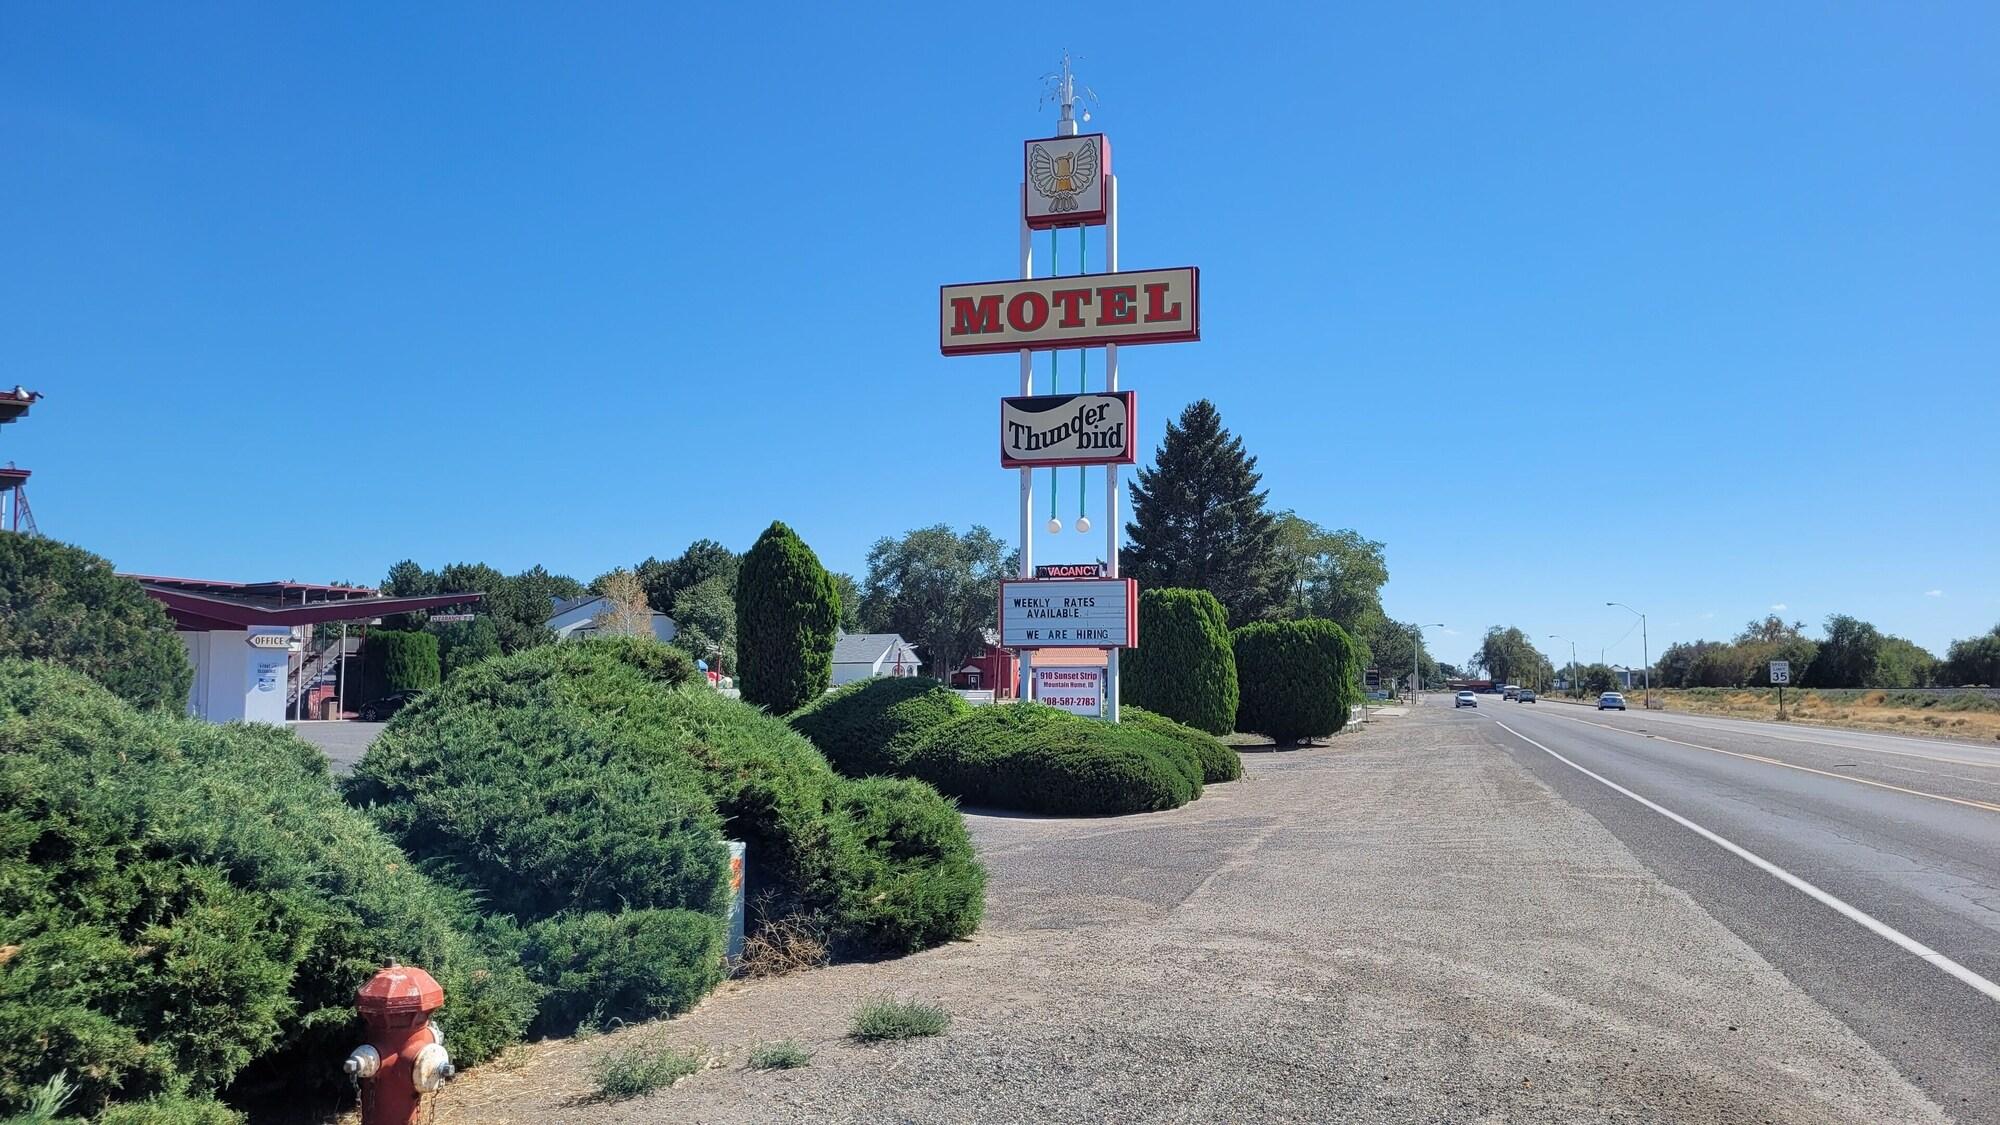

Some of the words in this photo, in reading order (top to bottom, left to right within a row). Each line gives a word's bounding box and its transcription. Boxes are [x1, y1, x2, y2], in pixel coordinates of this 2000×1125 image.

[951, 283, 1181, 336] MOTEL
[1009, 402, 1110, 451] Thunder
[1076, 423, 1123, 450] bird
[1047, 566, 1097, 577] VACANCY
[1013, 598, 1050, 607] WEEKLY
[1064, 597, 1095, 607] RATES
[1027, 608, 1079, 618] AVAILABLE
[1026, 630, 1039, 639] WE
[1048, 630, 1067, 639] ARE
[1076, 629, 1108, 639] HIRING
[255, 637, 284, 645] OFFICE
[1040, 672, 1053, 680] 910
[1054, 671, 1079, 680] Sunset
[1080, 671, 1097, 681] Strip
[1772, 672, 1787, 681] 35
